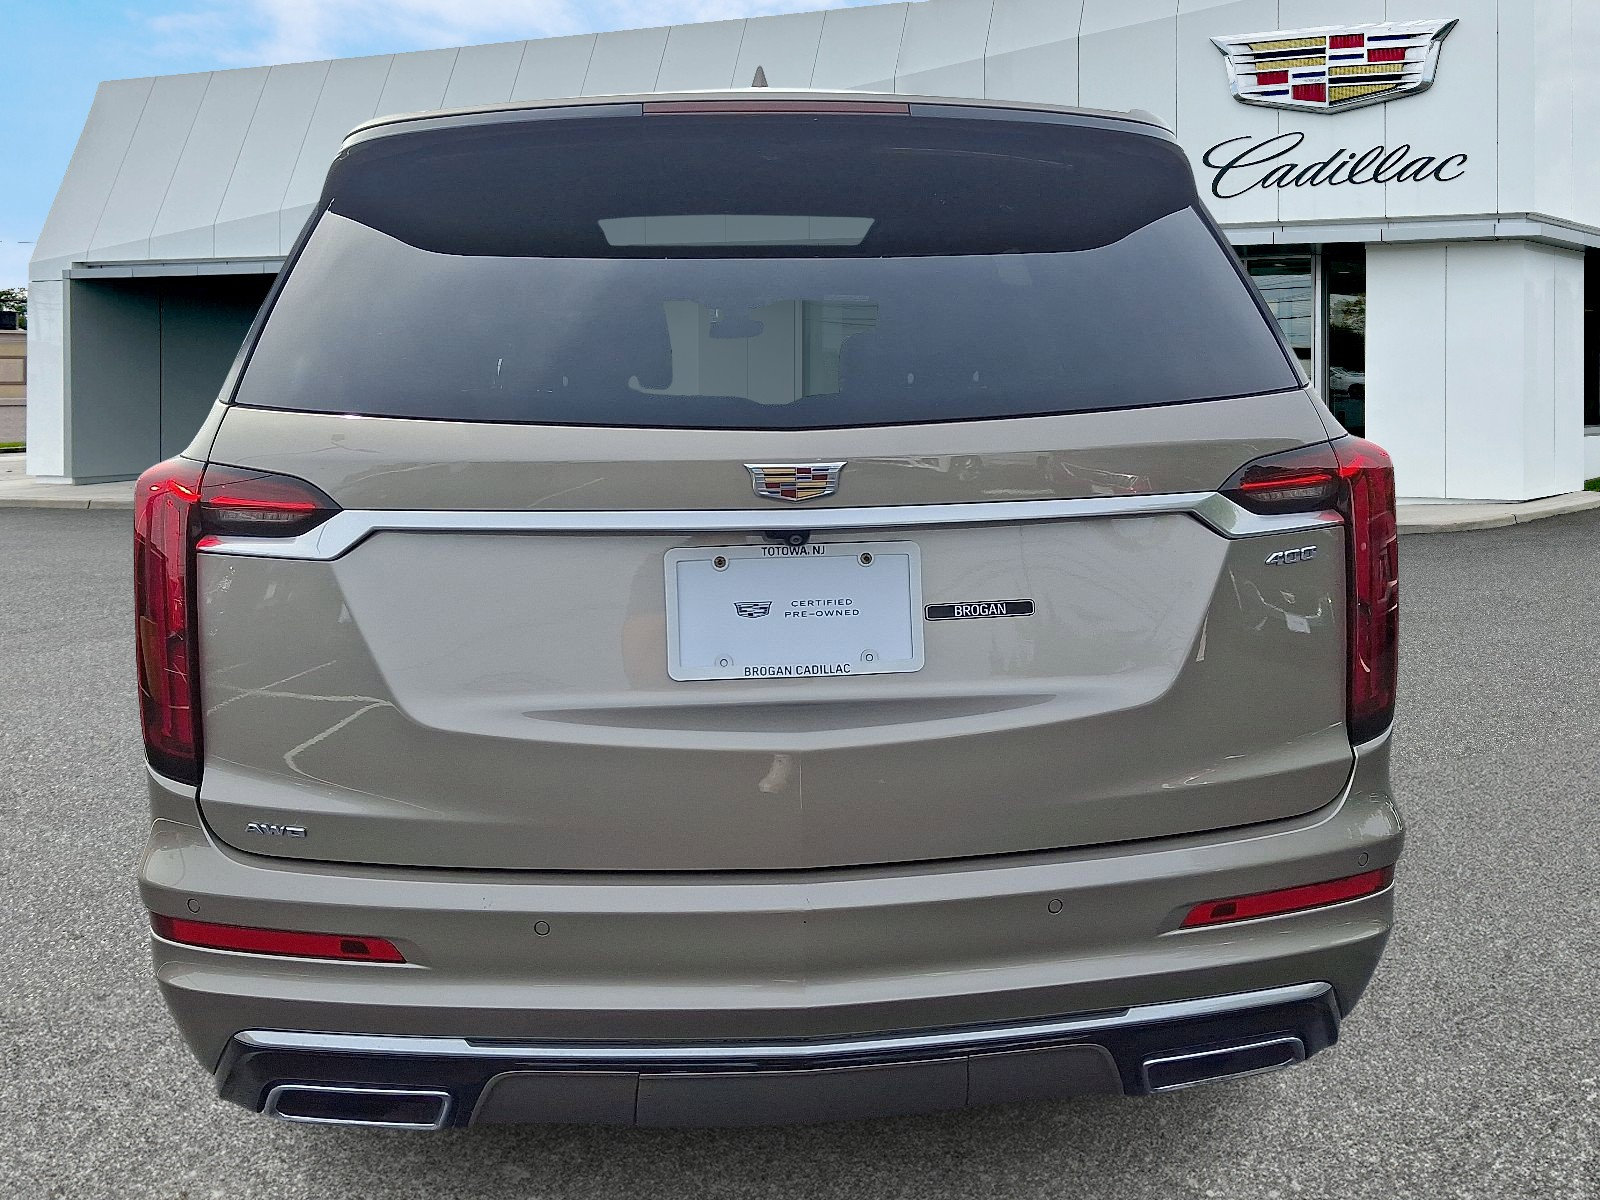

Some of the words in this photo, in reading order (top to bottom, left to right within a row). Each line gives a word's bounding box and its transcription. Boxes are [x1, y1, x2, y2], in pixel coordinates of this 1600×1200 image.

[1202, 131, 1468, 199] Cadillac
[812, 545, 825, 556] NJ
[1265, 544, 1318, 566] 400
[790, 598, 853, 608] CERTIFIED
[953, 602, 1007, 617] BROGAN
[784, 609, 860, 618] PRE-OWNED
[744, 666, 792, 677] BROGAN
[795, 663, 851, 675] CADILLAC
[244, 822, 307, 838] AWD
